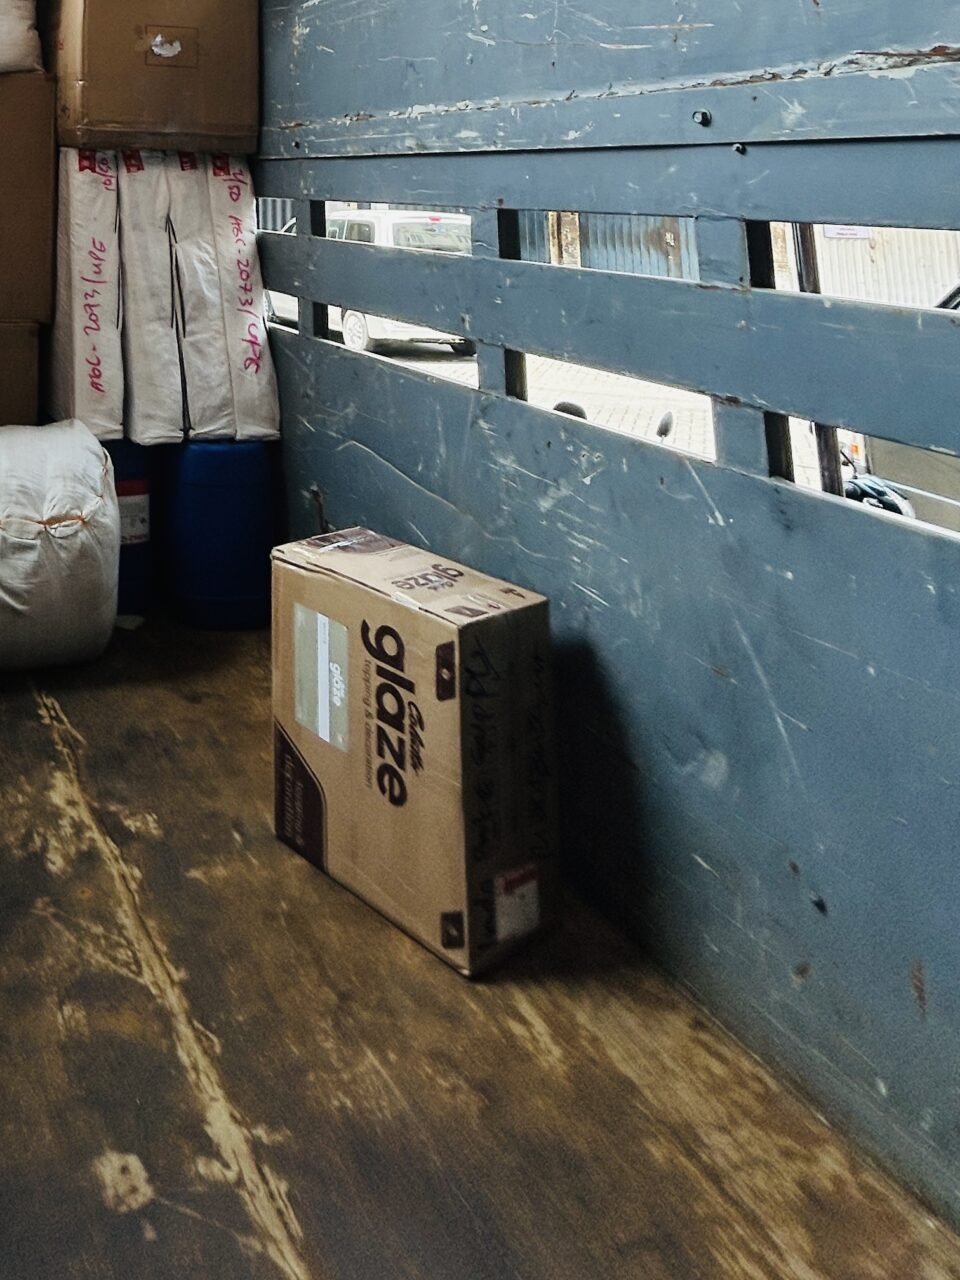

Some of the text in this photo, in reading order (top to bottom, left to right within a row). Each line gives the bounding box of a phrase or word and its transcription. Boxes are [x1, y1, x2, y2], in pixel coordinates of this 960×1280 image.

[389, 563, 465, 591] glaze
[329, 661, 345, 707] glaze
[361, 618, 419, 809] glaze
